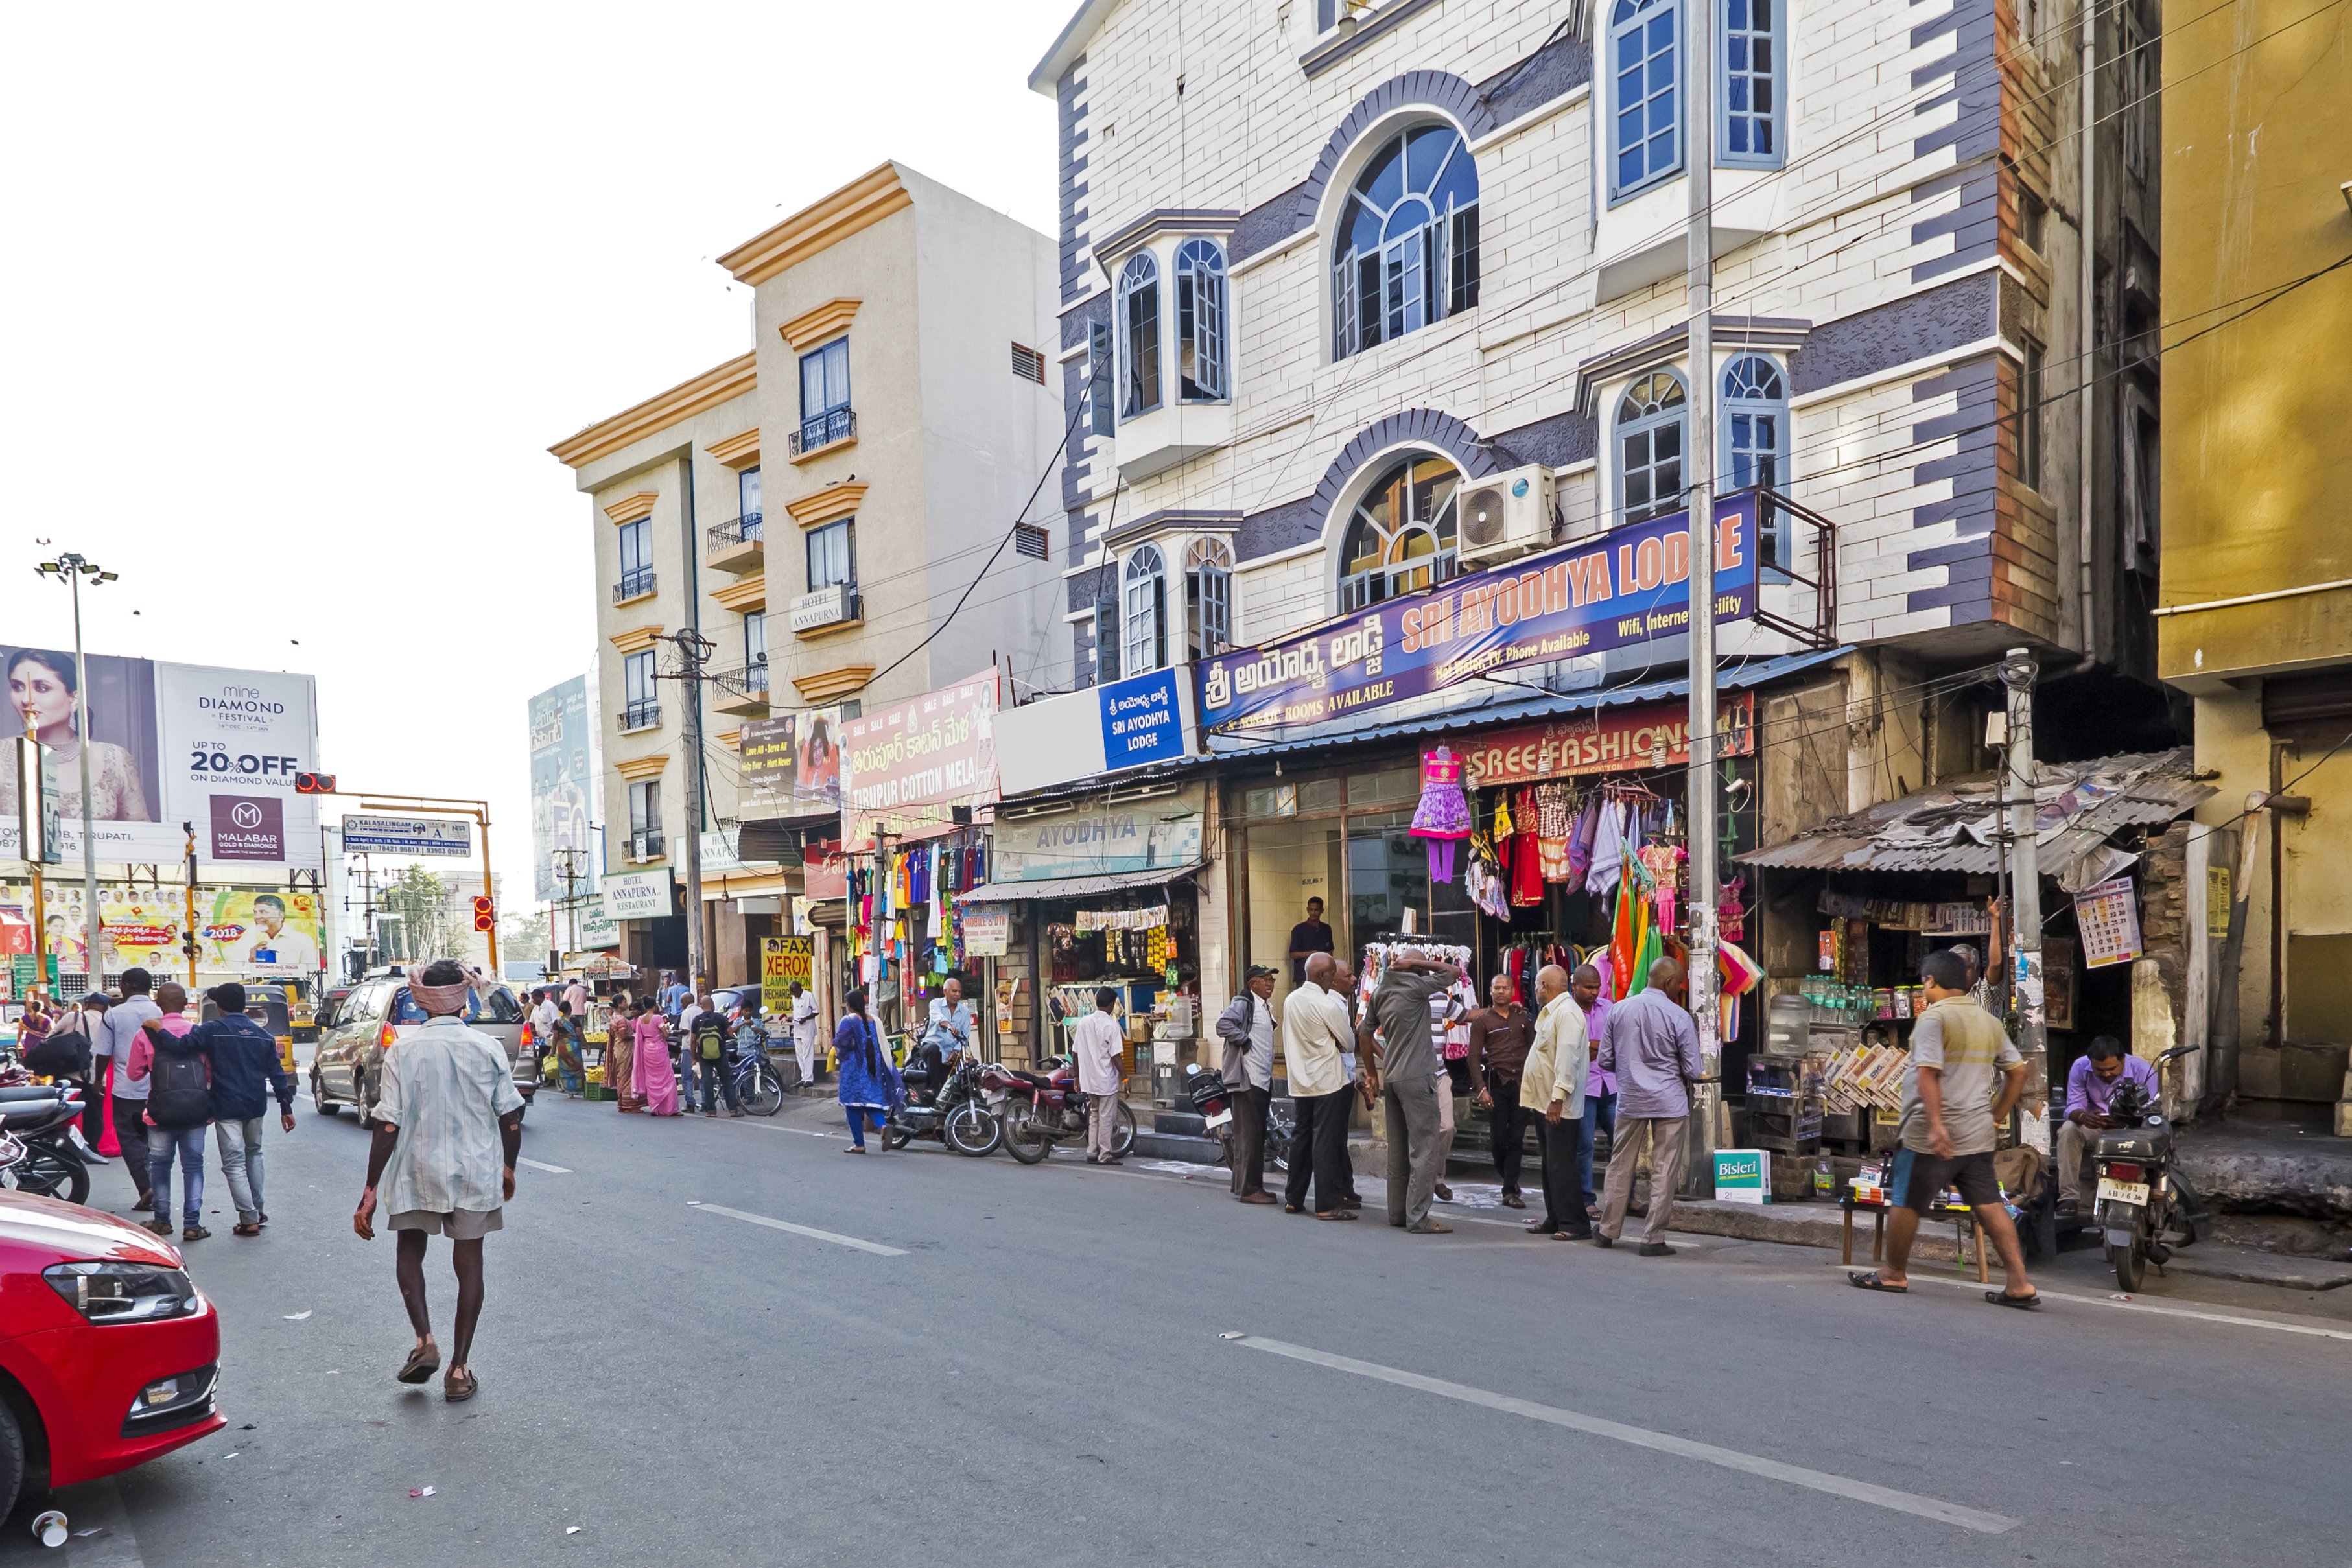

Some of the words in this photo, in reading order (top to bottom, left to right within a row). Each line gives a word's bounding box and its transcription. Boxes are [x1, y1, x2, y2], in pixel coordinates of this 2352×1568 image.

[1401, 596, 1453, 654] SRI
[1459, 550, 1613, 638] AYODHYA
[1619, 512, 1743, 597] LODE
[802, 593, 827, 609] HOTEL
[794, 607, 840, 627] ANNAPURNA
[1435, 663, 1452, 682] Hot
[1487, 650, 1503, 666] TV,
[1506, 644, 1538, 661] Phone
[1540, 629, 1590, 655] Available
[1618, 616, 1644, 638] Wifi,
[1646, 610, 1689, 632] Interne
[1205, 660, 1231, 710] శ్రీ
[1234, 637, 1327, 696] అయోధ్య
[224, 684, 260, 699] mine
[199, 697, 285, 714] DIAMOND
[1109, 698, 1118, 716] శ్రీ
[1118, 694, 1150, 708] అయోధ్య
[1284, 700, 1324, 721] ROOMS
[1327, 679, 1394, 713] AVAILABLE
[219, 712, 267, 724] FESTIVAL
[853, 723, 865, 737] SALE
[871, 718, 883, 731] SALE
[889, 712, 901, 726] SALE
[924, 699, 937, 713] SALE
[943, 692, 955, 707] SALE
[961, 684, 974, 699] SALE
[1112, 720, 1125, 735] SRI
[1127, 710, 1170, 732] AYODHYA
[192, 741, 208, 750] UP
[211, 742, 226, 751] TO
[1127, 732, 1158, 751] LODGE
[746, 747, 757, 756] Love
[767, 743, 780, 753] Serve
[752, 761, 762, 771] Ever
[766, 758, 778, 768] Hurt
[779, 757, 792, 766] Never
[1471, 743, 1537, 778] SREE
[1555, 767, 1588, 777] TIRUPUR
[1590, 763, 1623, 773] COTTON
[211, 775, 263, 785] DIAMOND
[853, 780, 899, 813] TIRUPUR
[901, 766, 943, 802] COTTON
[945, 756, 975, 790] MELA
[359, 819, 412, 828] KALASALINGAM
[1036, 812, 1137, 850] AYODHYA
[78, 830, 134, 841] TRUPATI.
[218, 833, 277, 843] MALABAR
[712, 834, 737, 845] HOTEL
[623, 875, 642, 886] HOTEL
[612, 885, 657, 900] ANNAPURNA
[617, 899, 657, 911] RESTAURANT
[965, 916, 987, 928] MOBILE
[988, 915, 993, 926] &
[994, 914, 1007, 926] DTH
[210, 928, 239, 939] 2018
[780, 939, 810, 954] FAX
[766, 955, 810, 976] XEROX
[1719, 1161, 1756, 1176] Bisleri
